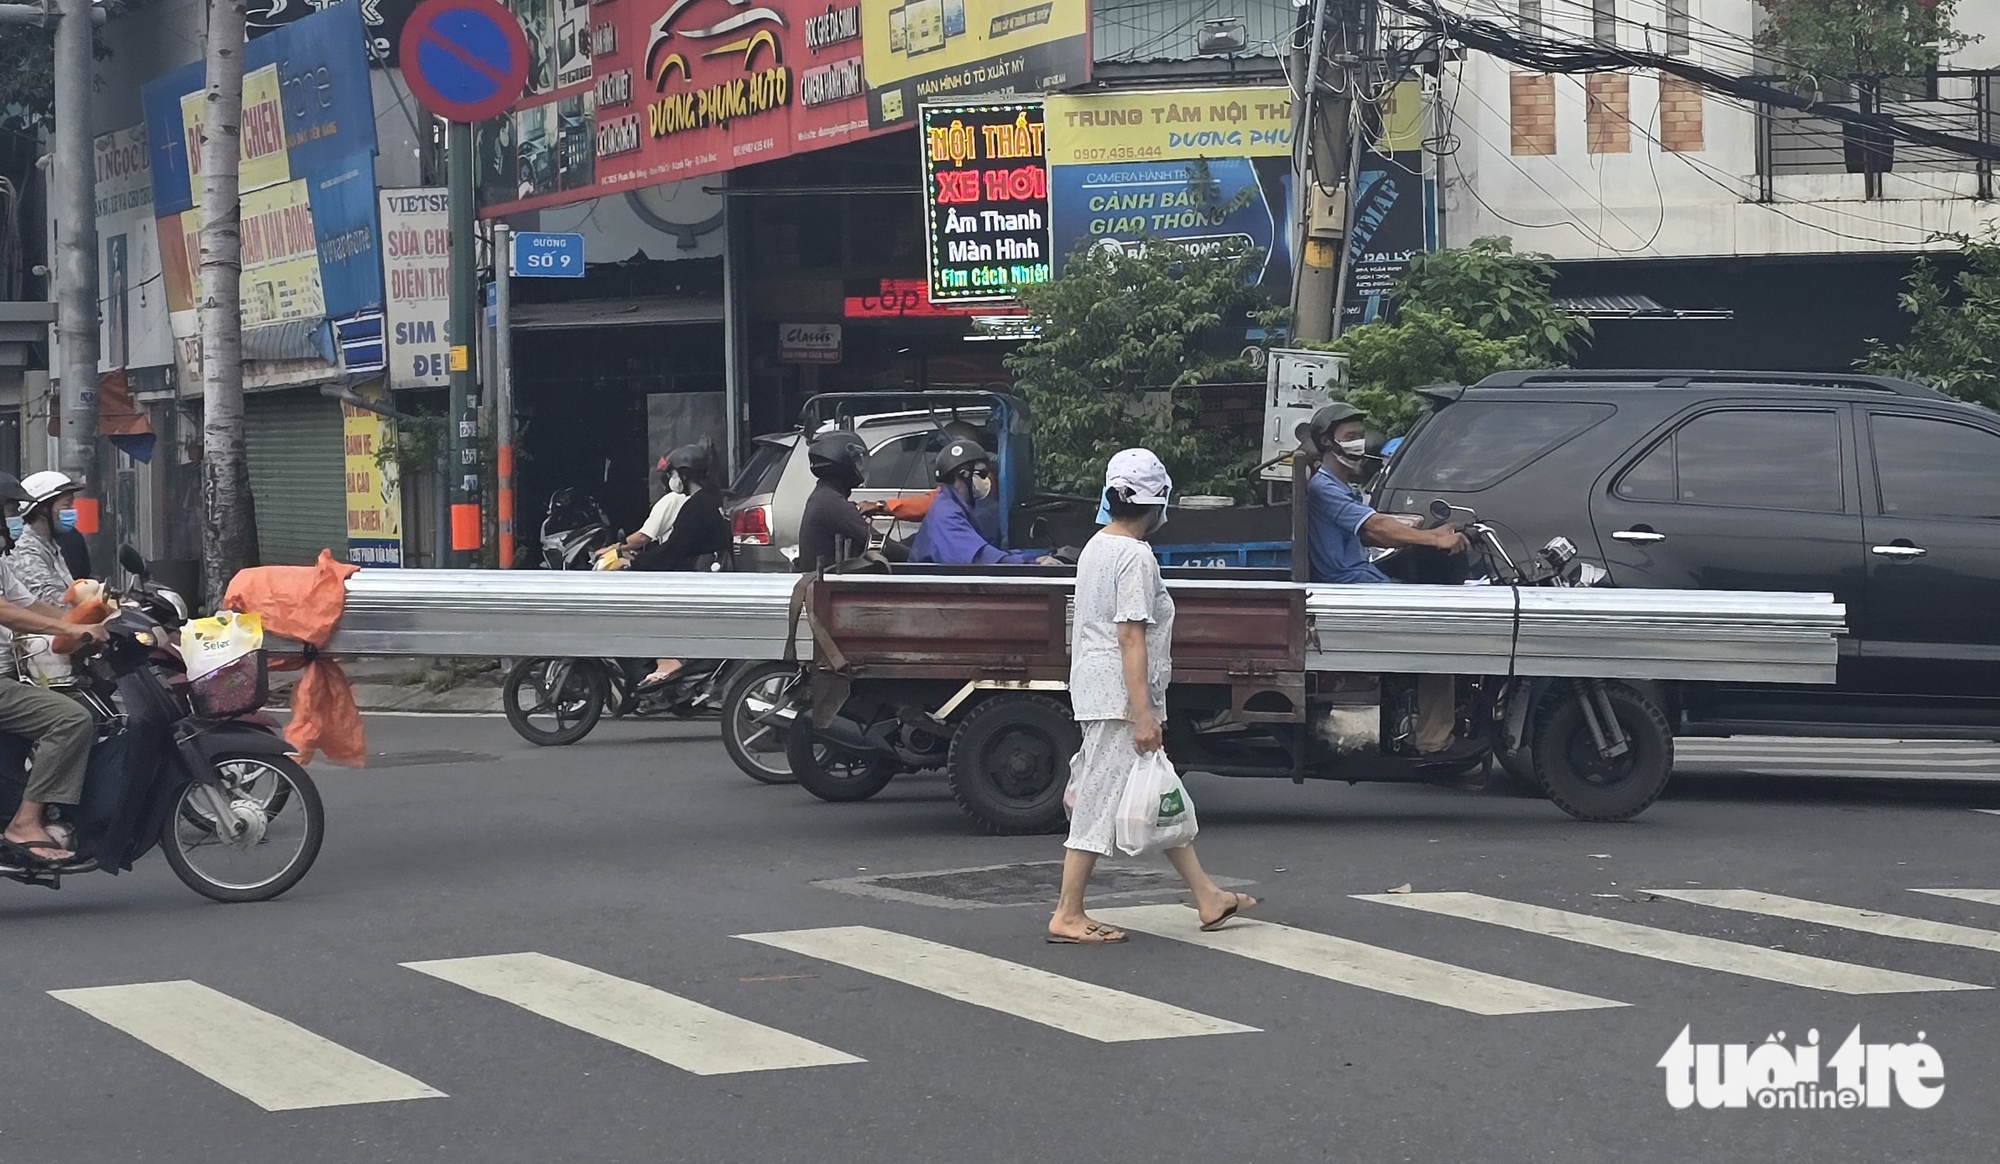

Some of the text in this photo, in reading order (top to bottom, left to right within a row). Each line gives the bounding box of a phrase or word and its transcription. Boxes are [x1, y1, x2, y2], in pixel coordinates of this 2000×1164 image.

[749, 66, 787, 116] AUTO
[1065, 109, 1143, 128] TRUNG
[1151, 103, 1201, 124] TÂM
[1209, 100, 1247, 125] NỘI
[931, 111, 1044, 166] NỘI THẤT
[1074, 146, 1162, 160] 0907.435.444
[935, 165, 1047, 204] XE HƠI
[1086, 171, 1138, 184] CAMERA
[1139, 170, 1171, 182] HÀNH
[1089, 190, 1156, 212] CẢNH
[945, 207, 1042, 234] Âm Thanh
[1090, 209, 1225, 235] GIAO THÔNG
[320, 222, 372, 267] vinaphone
[533, 236, 567, 248] ĐƯỜNG
[948, 237, 1040, 262] Màn Hình
[528, 250, 571, 268] SỐ 9
[391, 261, 426, 309] ĐIỆN
[972, 265, 1008, 287] Cách
[1010, 263, 1050, 286] Nhiệt
[396, 321, 436, 346] SIM
